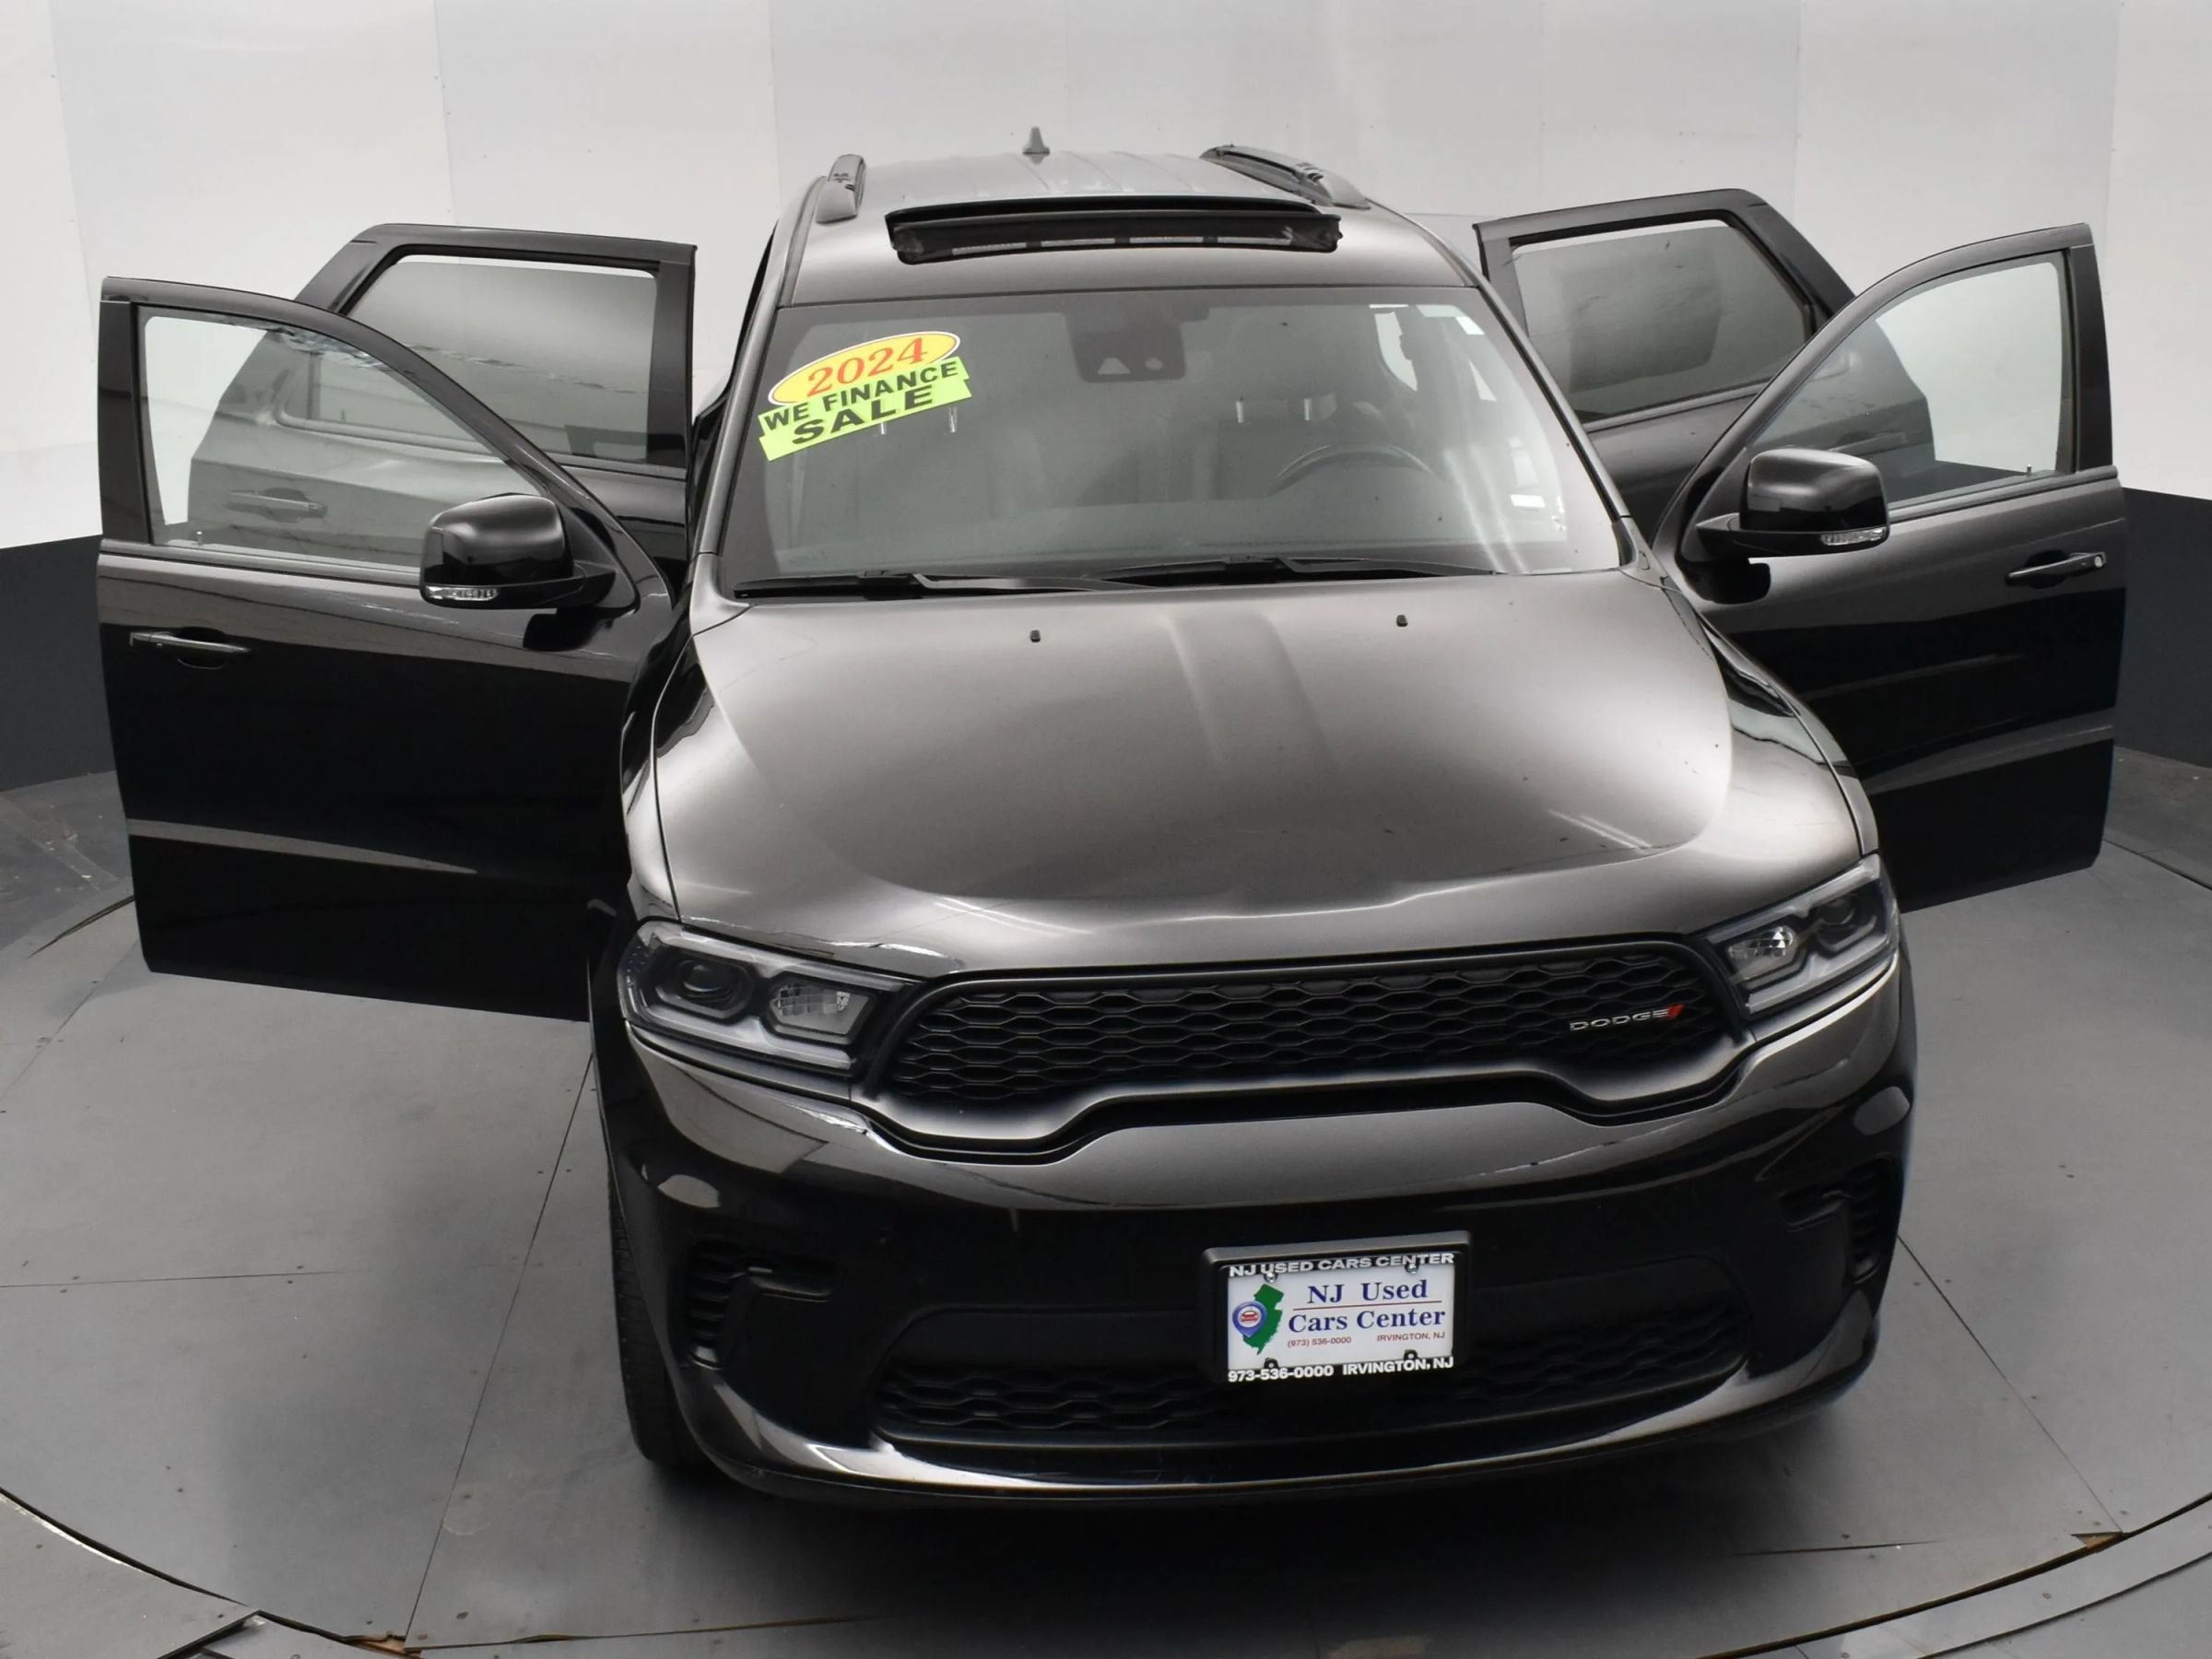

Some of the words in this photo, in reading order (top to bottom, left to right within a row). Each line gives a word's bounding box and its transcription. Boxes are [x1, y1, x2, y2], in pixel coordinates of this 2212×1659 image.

[806, 337, 928, 398] 2024
[764, 402, 809, 431] WE
[822, 360, 959, 412] FINANCE
[792, 384, 934, 445] SALE
[1570, 1008, 1669, 1030] DODGE
[1229, 1265, 1256, 1277] NJ
[1261, 1260, 1313, 1274] USED
[1318, 1257, 1371, 1271] CARS
[1374, 1253, 1454, 1267] CENTER
[1307, 1284, 1346, 1304] NJ
[1361, 1279, 1428, 1301] Used
[1288, 1312, 1348, 1333] Cars
[1357, 1309, 1446, 1328] Center
[1287, 1337, 1310, 1348] (973)
[1377, 1333, 1430, 1342] IRVINGTON,
[1228, 1365, 1334, 1382] 973-536-0000
[1343, 1359, 1430, 1375] IRVINGTON,
[1433, 1357, 1453, 1369] NJ
